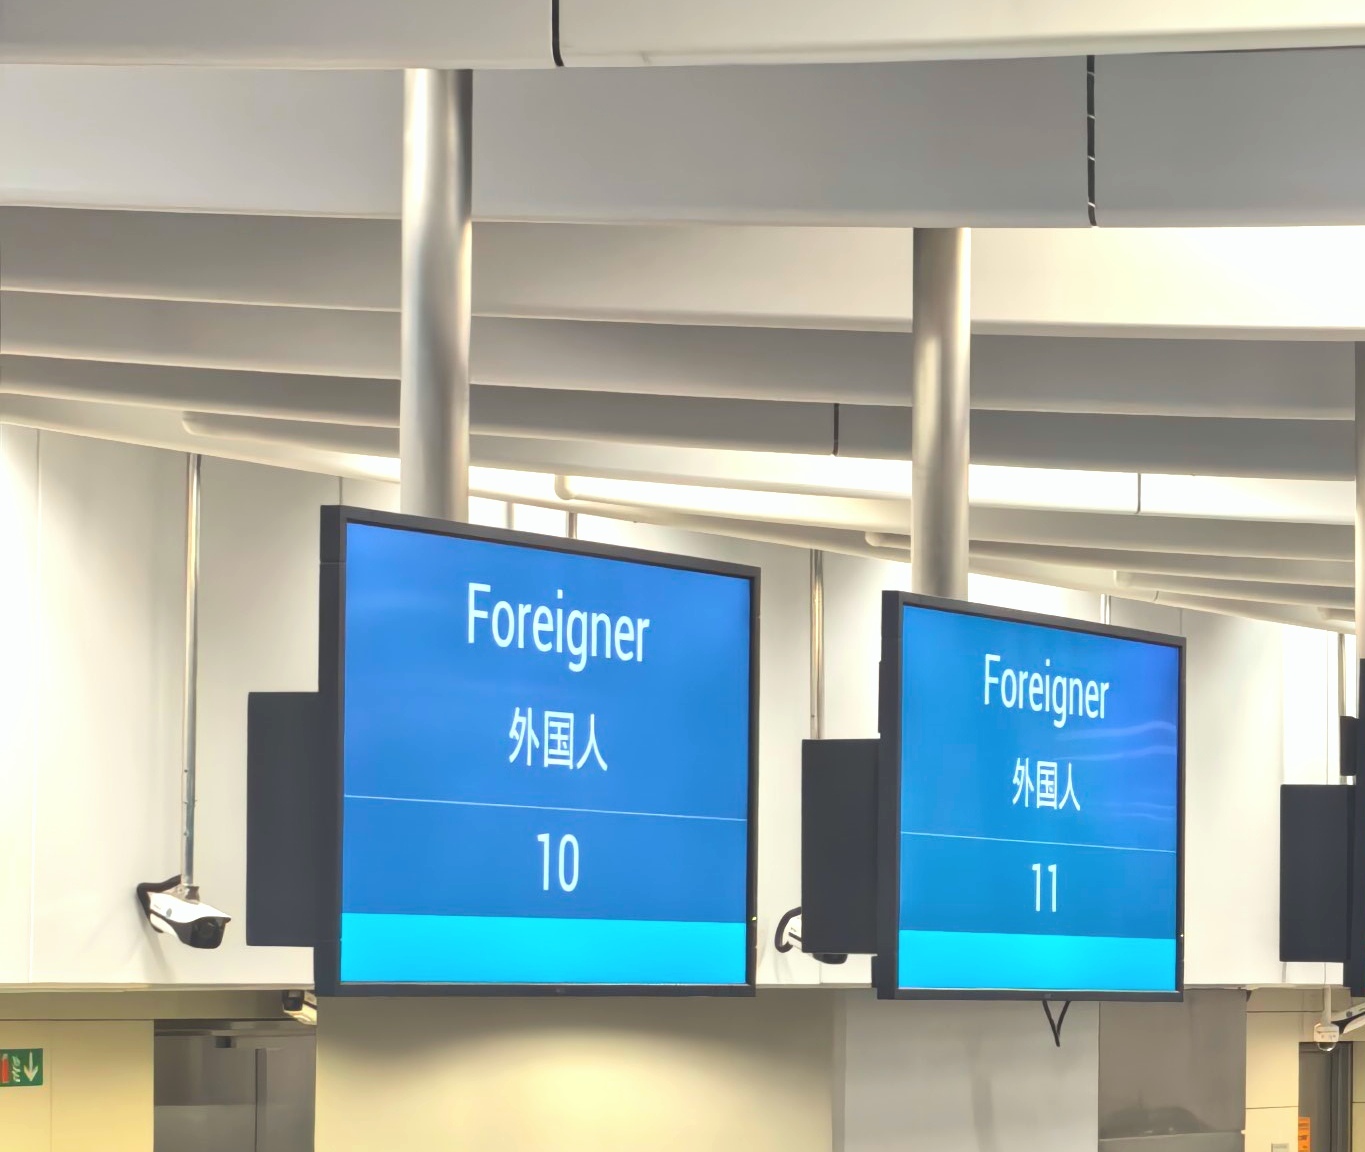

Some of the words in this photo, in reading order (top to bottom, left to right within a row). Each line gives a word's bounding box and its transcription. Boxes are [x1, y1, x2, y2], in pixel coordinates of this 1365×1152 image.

[466, 581, 650, 673] Foreigner
[983, 653, 1109, 728] Foreigner
[507, 706, 609, 772] 外国人
[1011, 757, 1081, 812] 外国人
[536, 831, 579, 894] 10
[1030, 862, 1059, 912] 11
